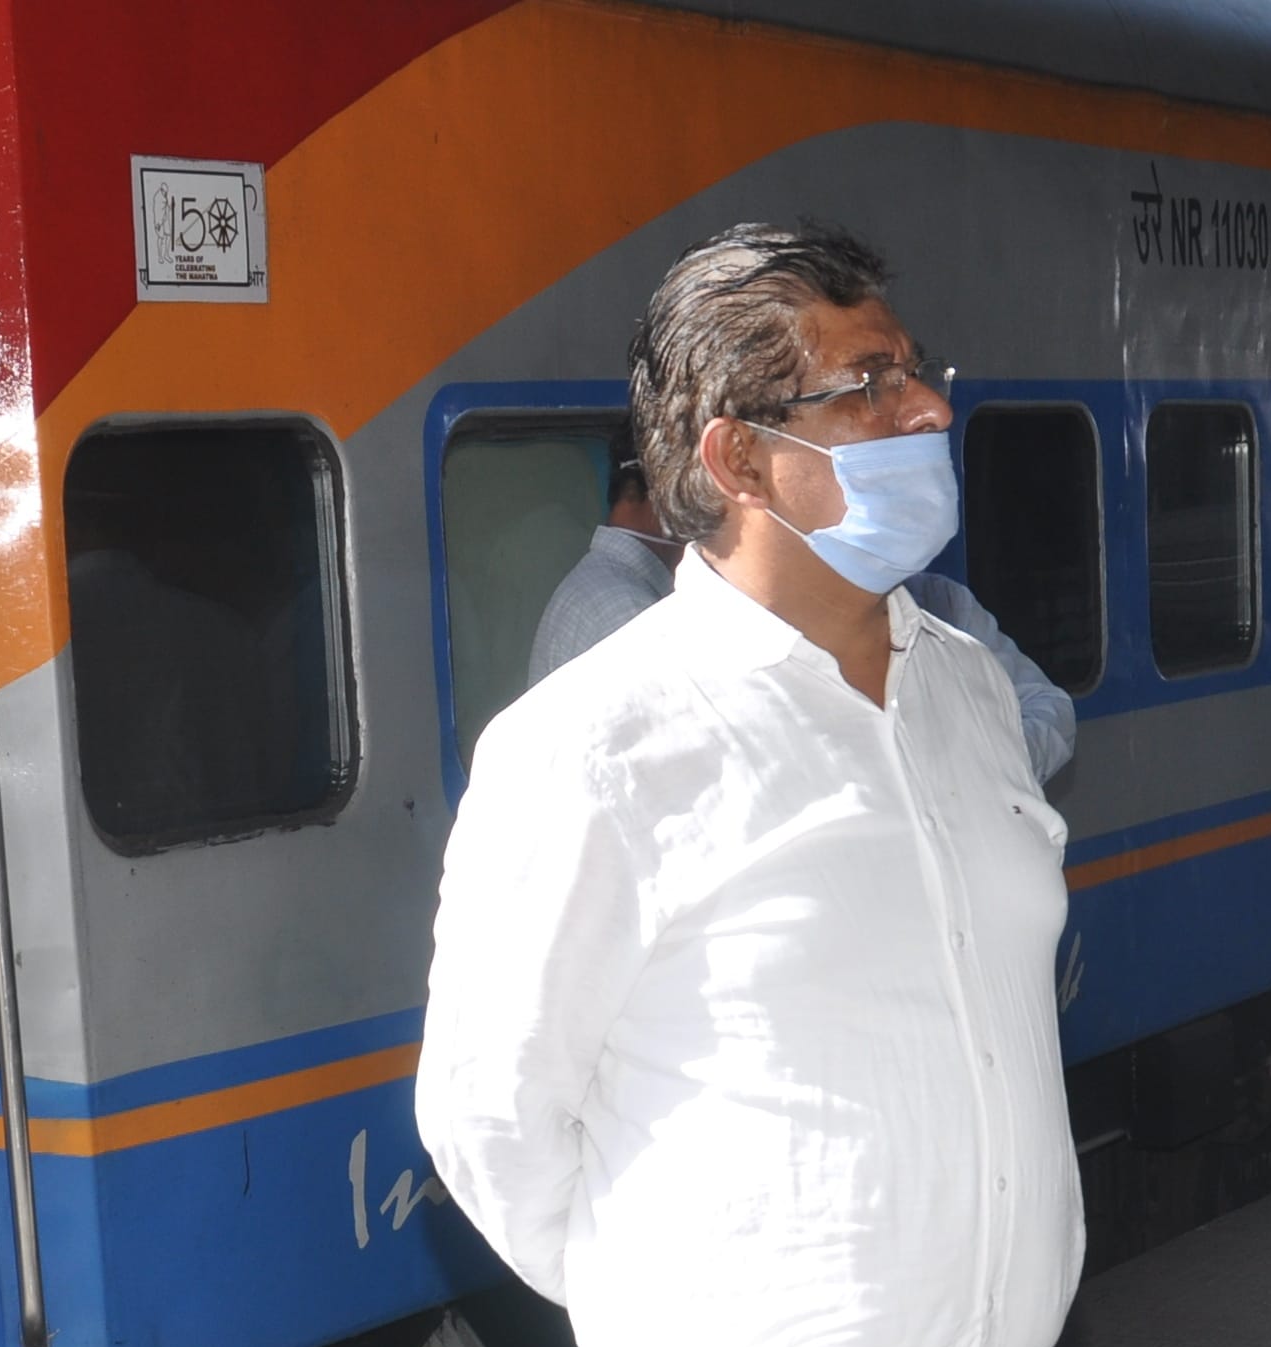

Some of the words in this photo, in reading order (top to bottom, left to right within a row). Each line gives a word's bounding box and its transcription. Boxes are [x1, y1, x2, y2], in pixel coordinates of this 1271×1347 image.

[1171, 197, 1203, 267] NR
[1211, 200, 1269, 270] 11030
[175, 255, 194, 264] YEARS
[196, 256, 204, 264] OF
[175, 264, 216, 273] CELEBRATING
[189, 273, 218, 281] MAHATMA
